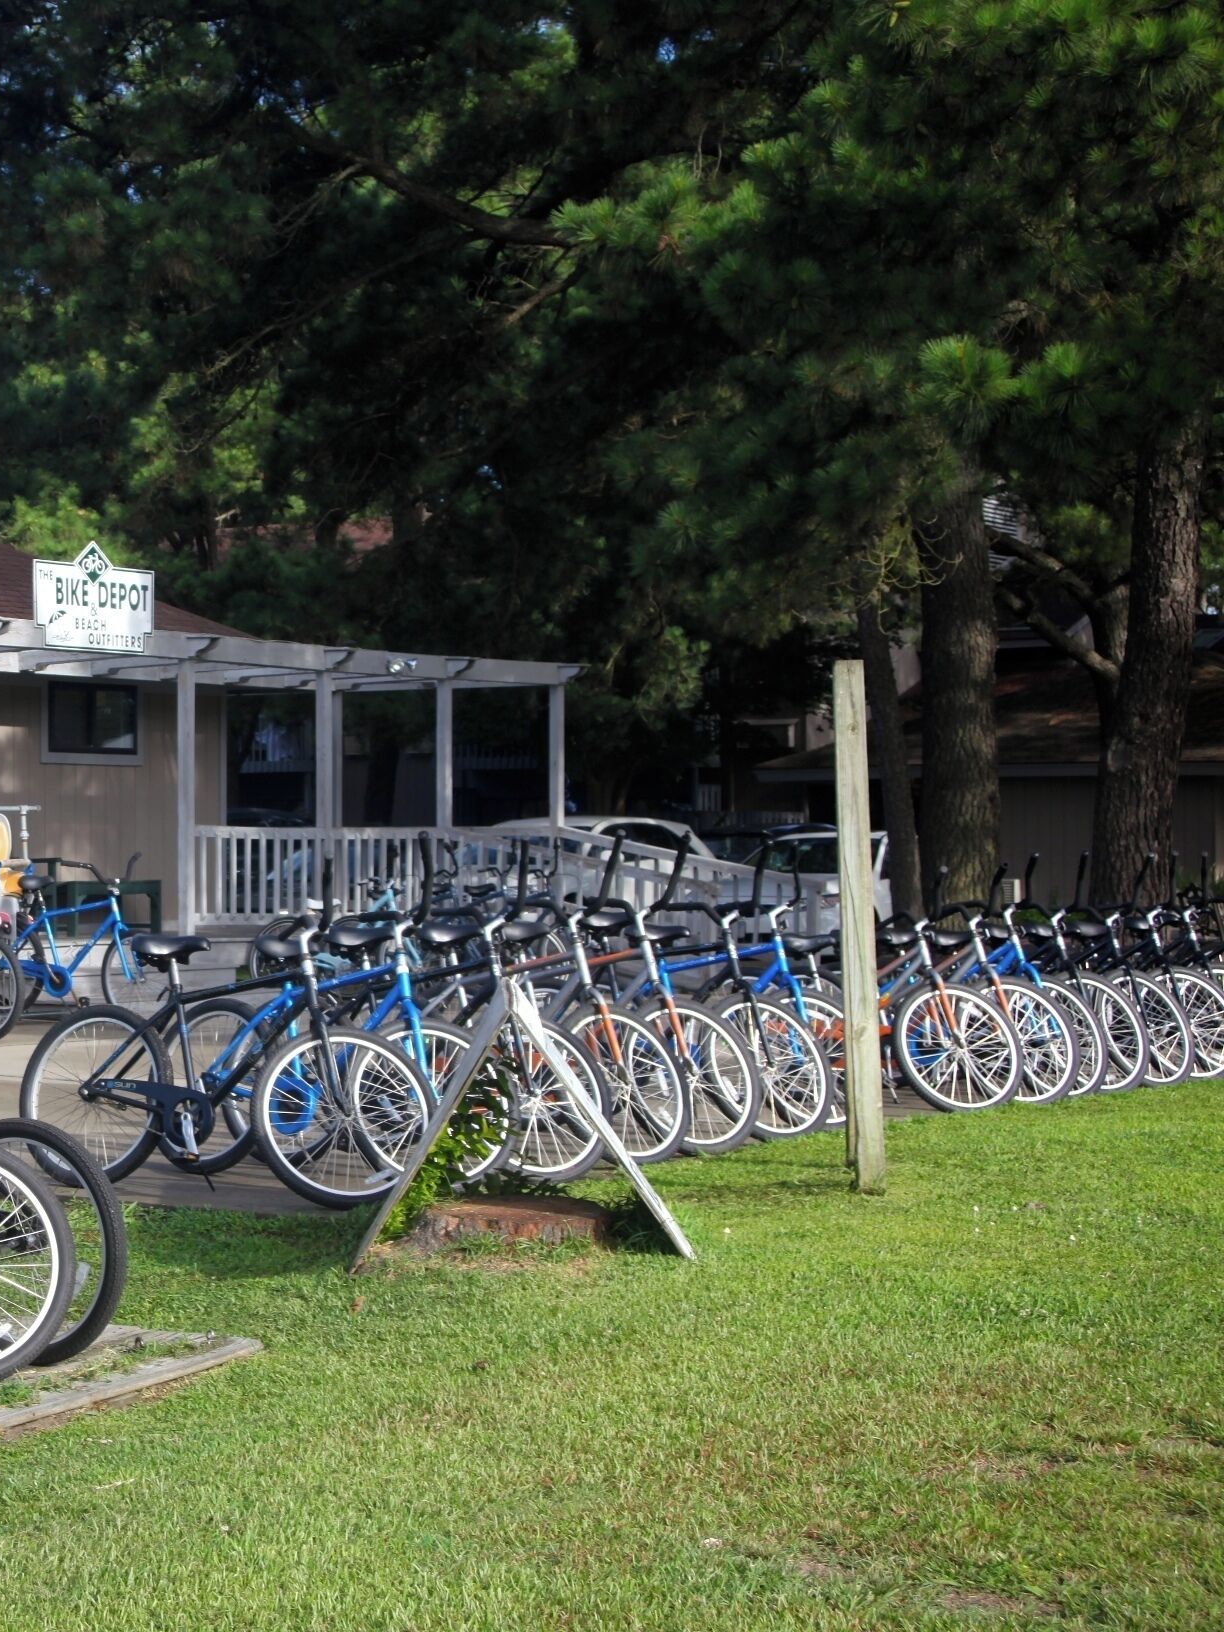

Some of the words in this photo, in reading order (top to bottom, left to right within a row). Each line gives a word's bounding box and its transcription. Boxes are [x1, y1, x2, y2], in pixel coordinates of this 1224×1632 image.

[39, 569, 53, 580] THE
[55, 577, 89, 607] BIKE
[98, 581, 149, 612] DEPOT
[90, 602, 98, 617] &
[75, 617, 107, 631] BEACH
[88, 632, 143, 649] OUTFITTERS
